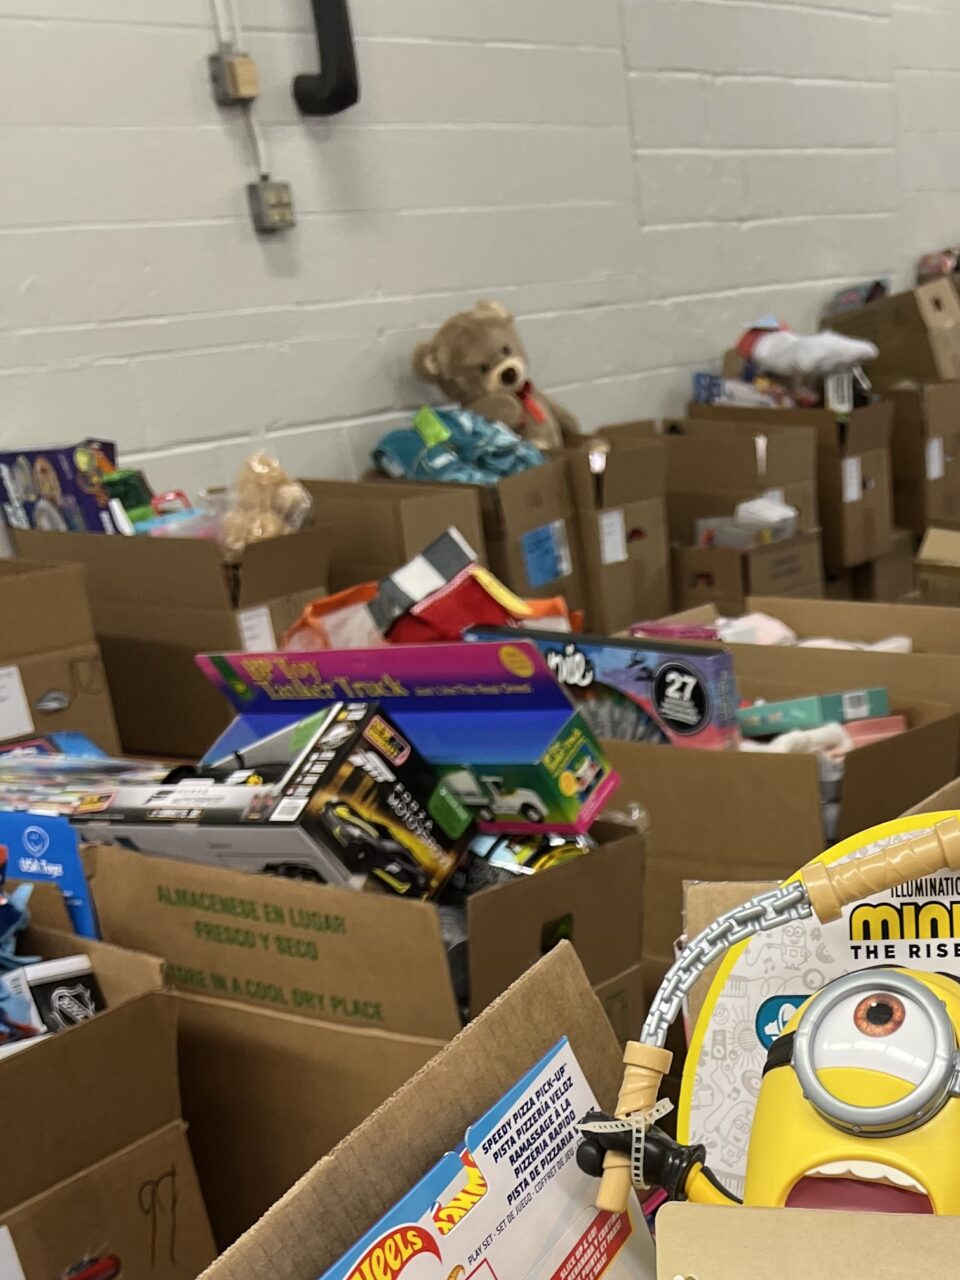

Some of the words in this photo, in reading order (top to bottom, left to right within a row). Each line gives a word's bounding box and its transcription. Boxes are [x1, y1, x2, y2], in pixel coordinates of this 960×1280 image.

[665, 671, 698, 700] 27
[274, 934, 320, 960] SECO
[850, 945, 896, 960] THE
[481, 1119, 514, 1156] SPEEDY
[511, 1093, 536, 1126] PIZZA
[492, 1140, 519, 1164] PISTA
[516, 1101, 553, 1145] PIZZERÍA
[550, 1076, 575, 1106] VELOZ
[508, 1120, 557, 1167] RAMASSAGE
[550, 1109, 577, 1142] RAPIDO
[506, 1180, 531, 1207] PISTA
[538, 1132, 577, 1175] PIZZARIA
[467, 1247, 484, 1266] PLAY
[515, 1192, 534, 1216] JUEGO
